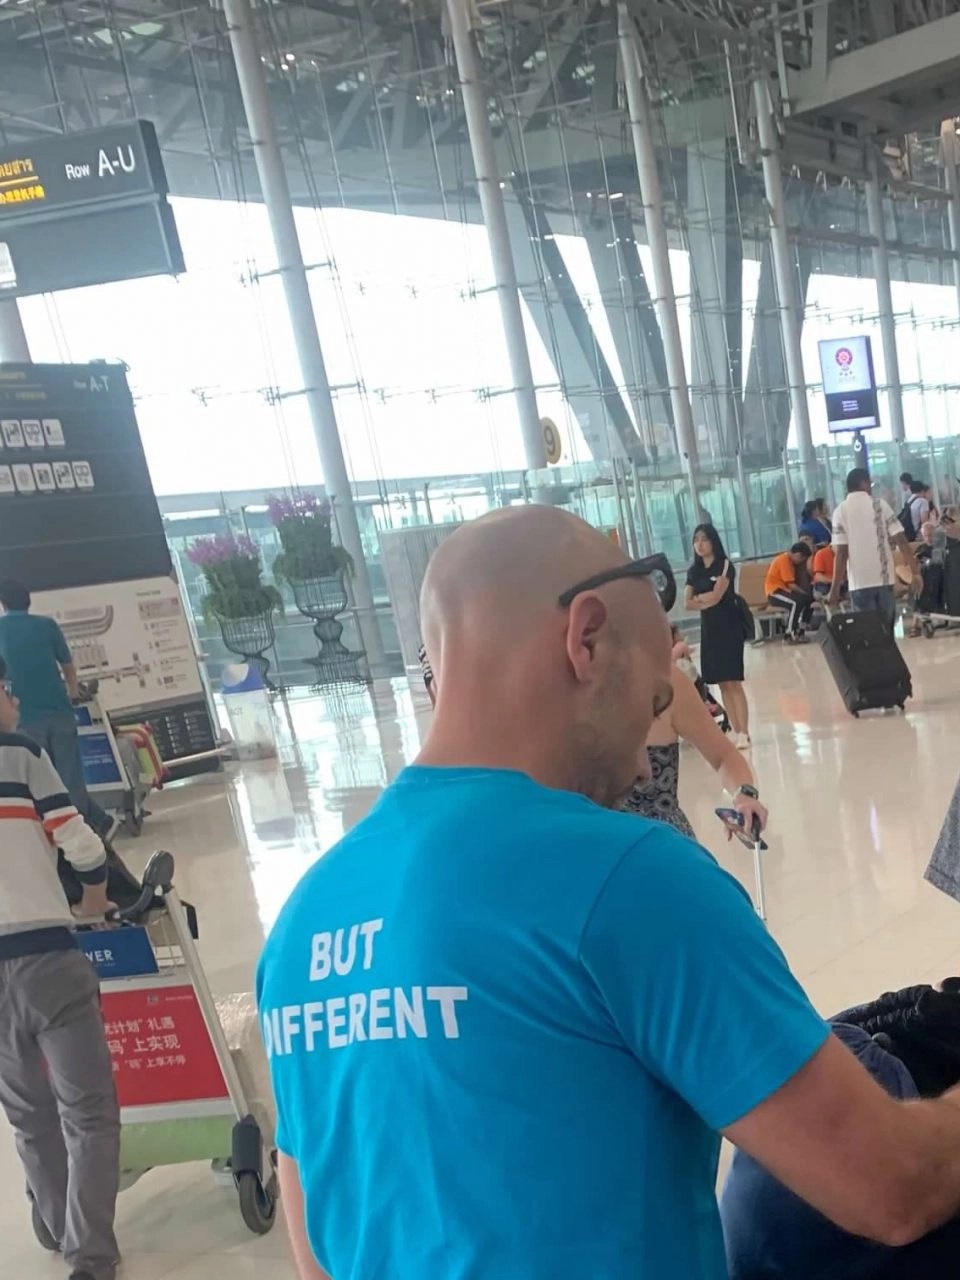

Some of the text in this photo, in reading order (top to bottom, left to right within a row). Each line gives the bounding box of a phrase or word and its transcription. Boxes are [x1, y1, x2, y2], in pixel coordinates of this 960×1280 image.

[65, 145, 136, 180] Row A-U
[543, 425, 556, 456] 9
[308, 917, 384, 982] BUT
[263, 985, 468, 1059] DIFFERENT
